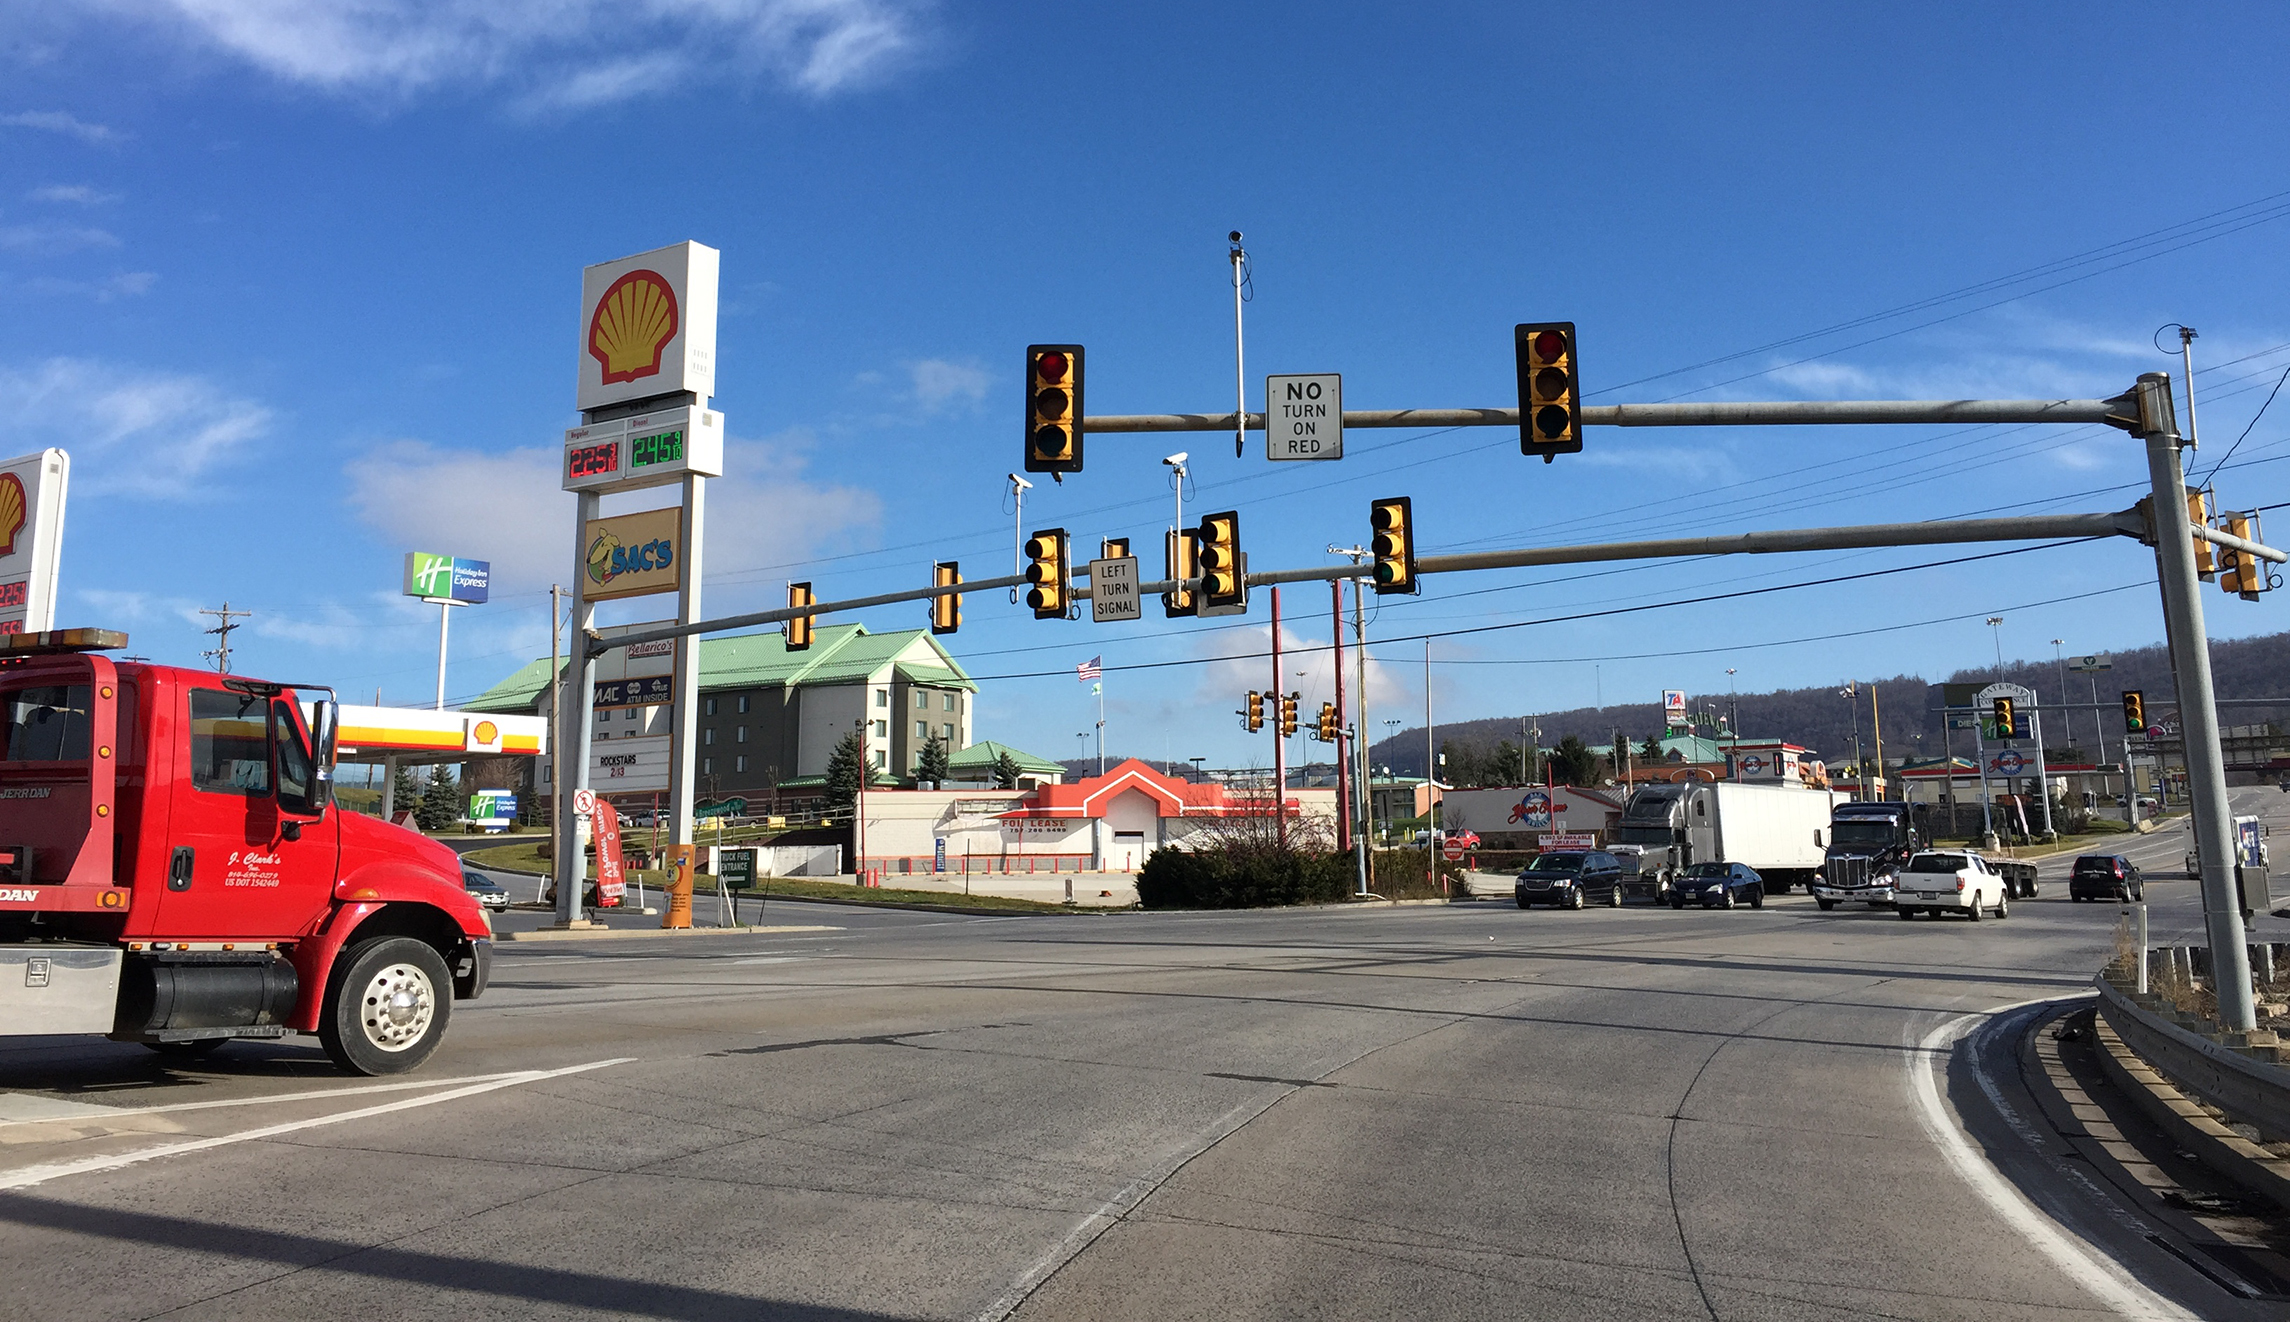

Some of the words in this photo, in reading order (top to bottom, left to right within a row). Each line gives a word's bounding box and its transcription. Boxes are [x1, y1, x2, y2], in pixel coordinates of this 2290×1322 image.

[1287, 382, 1322, 400] NO
[1282, 404, 1326, 418] TURN
[1293, 422, 1316, 436] ON
[1288, 440, 1320, 453] RED
[611, 538, 673, 575] SAC'S
[455, 567, 478, 578] Holiday
[478, 569, 488, 577] Inn
[1101, 565, 1126, 578] LEFT
[454, 575, 487, 588] Express
[1102, 582, 1129, 596] TURN
[1097, 600, 1136, 615] SIGNAL
[628, 641, 673, 654] Bellarico's
[1980, 683, 2026, 699] GATEWAY
[626, 695, 642, 704] ATM
[643, 692, 668, 703] INSIDE
[1667, 693, 1684, 706] TA
[600, 754, 637, 767] ROCKSTARS
[1002, 819, 1024, 827] FOR
[1030, 819, 1066, 827] LEASE
[227, 852, 240, 866] J.
[243, 852, 281, 865] Clark's
[737, 851, 750, 861] FUEL
[721, 862, 748, 871] ENTRANCE
[225, 878, 235, 886] US
[235, 878, 251, 886] DOT
[0, 889, 39, 901] DAN
